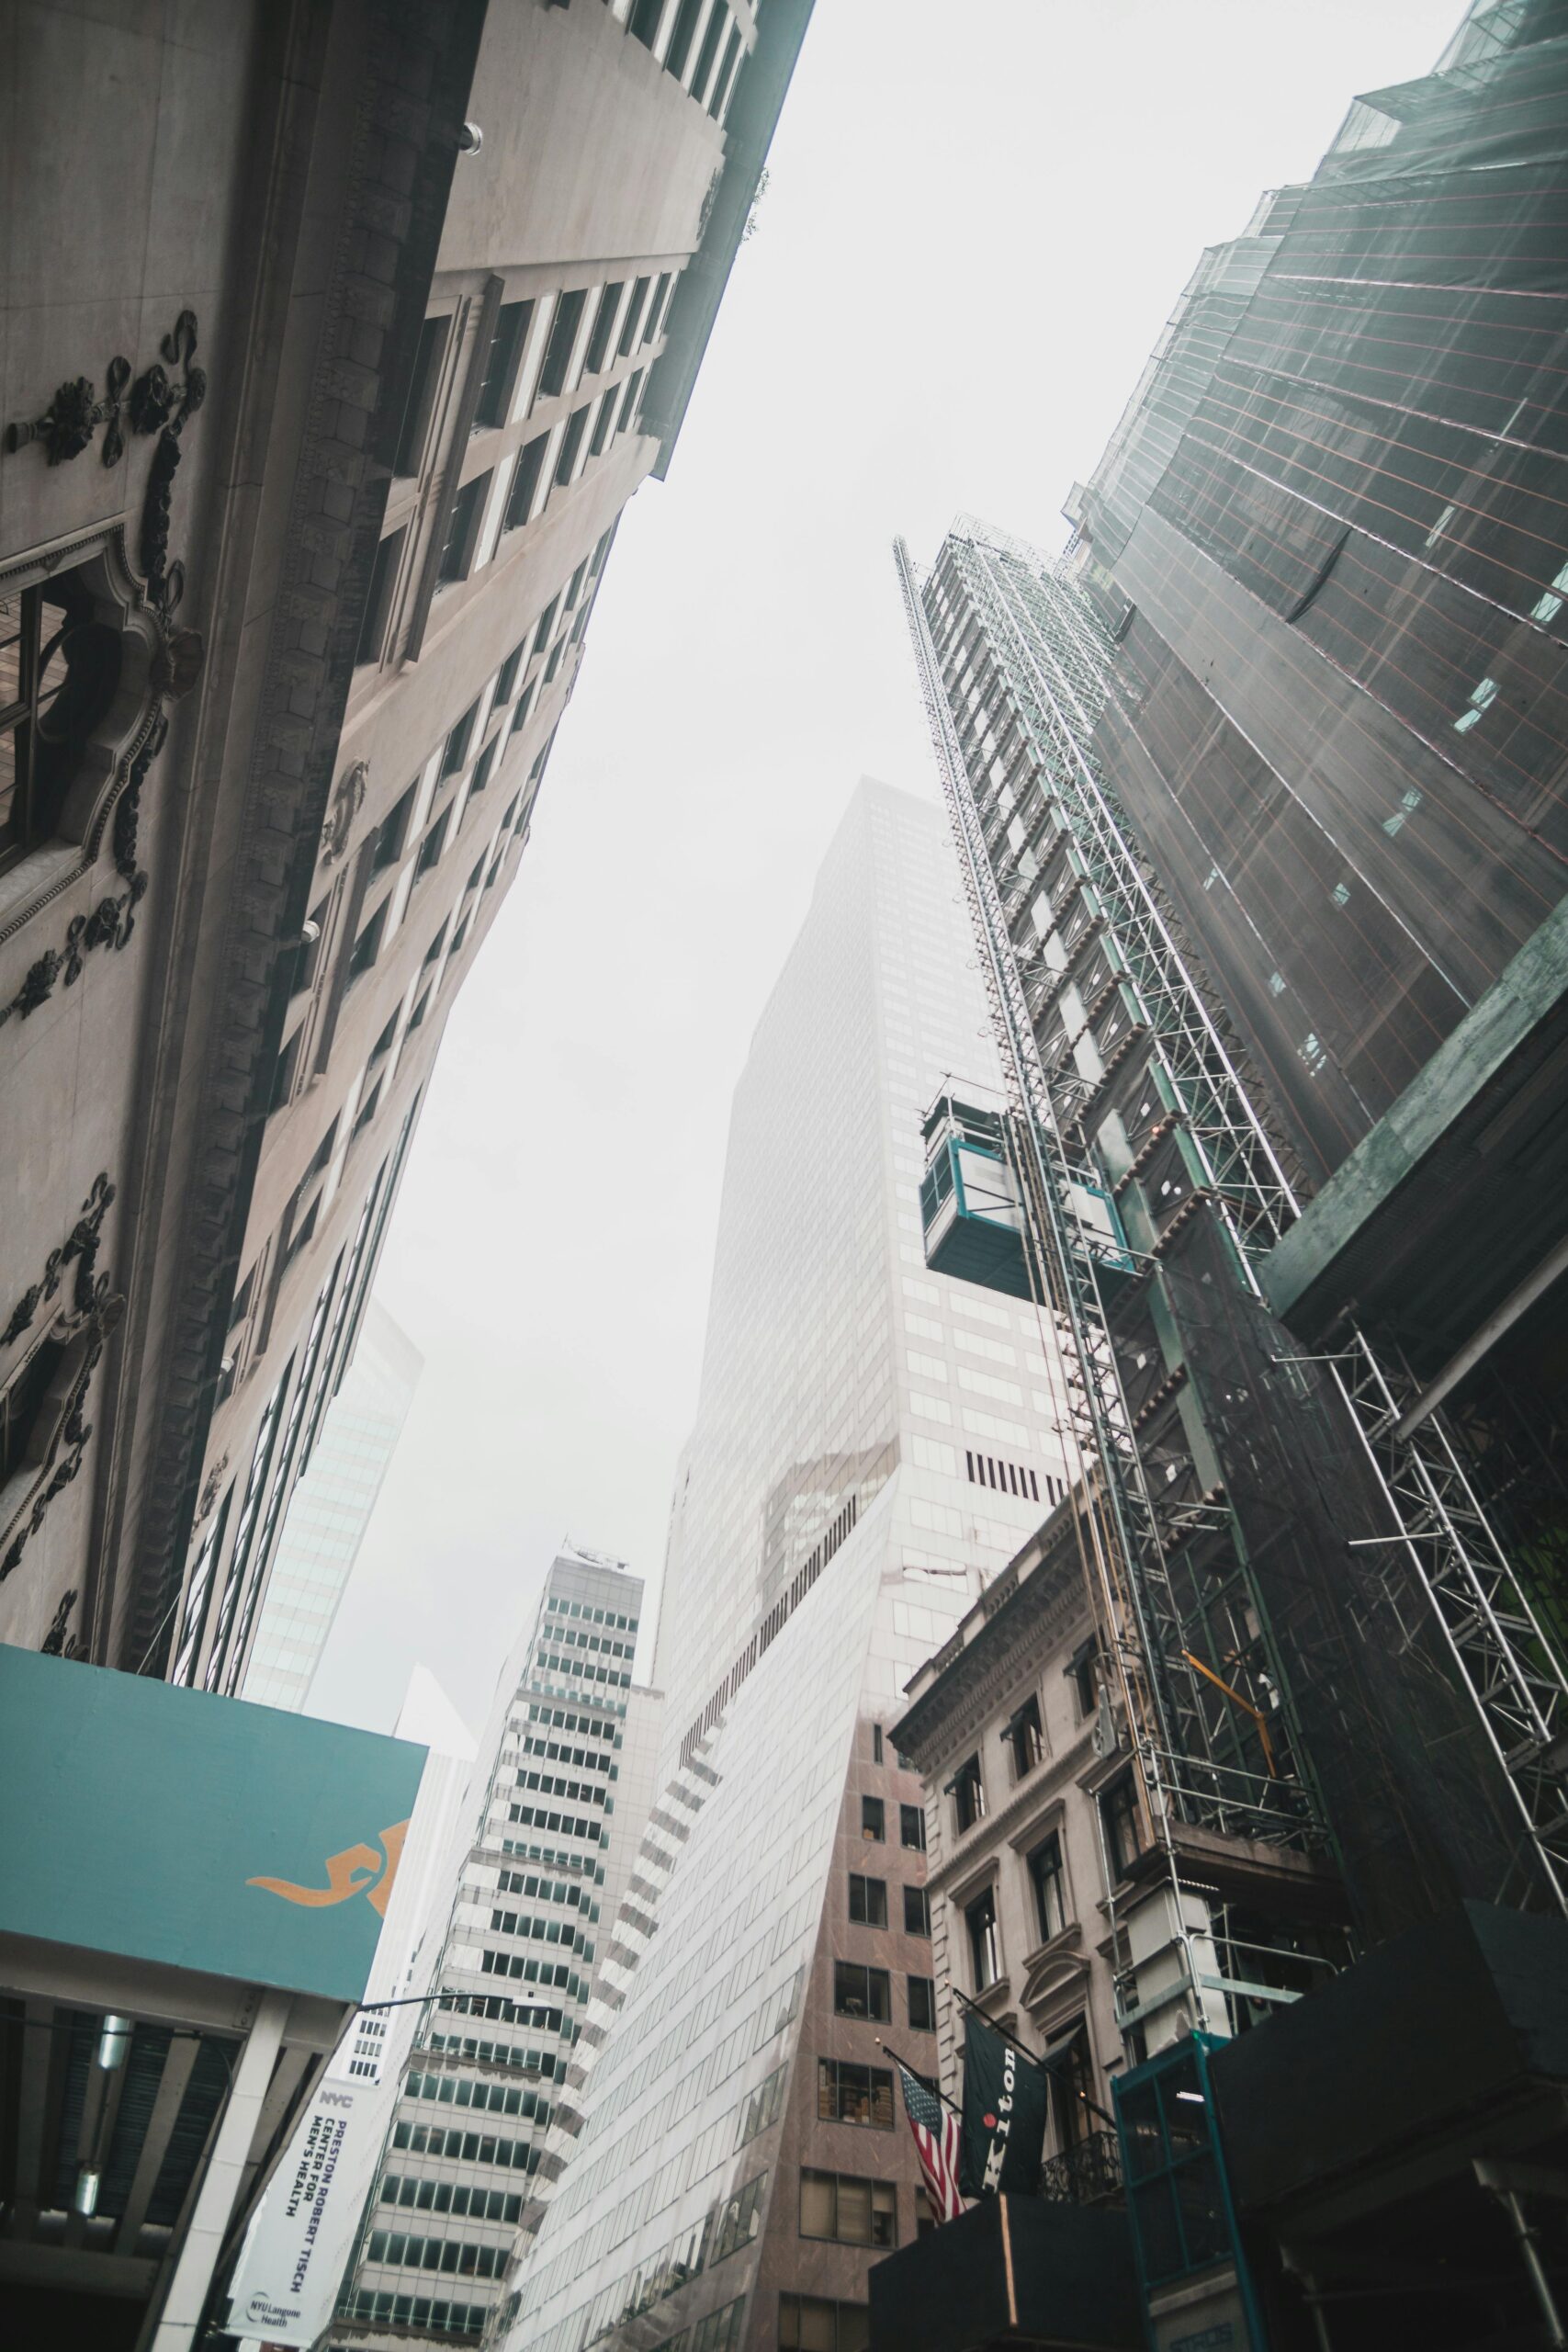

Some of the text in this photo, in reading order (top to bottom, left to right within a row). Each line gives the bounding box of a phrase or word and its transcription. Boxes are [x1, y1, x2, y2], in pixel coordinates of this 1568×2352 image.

[319, 2090, 354, 2109] NYC
[982, 2047, 1016, 2194] Kiton
[286, 2115, 323, 2218] MEN'S HEALTH
[303, 2118, 335, 2202] CENTER FOR
[289, 2120, 347, 2293] PRESTON ROBERT TISCH
[250, 2301, 301, 2318] NYU Langone
[261, 2315, 288, 2328] Health
